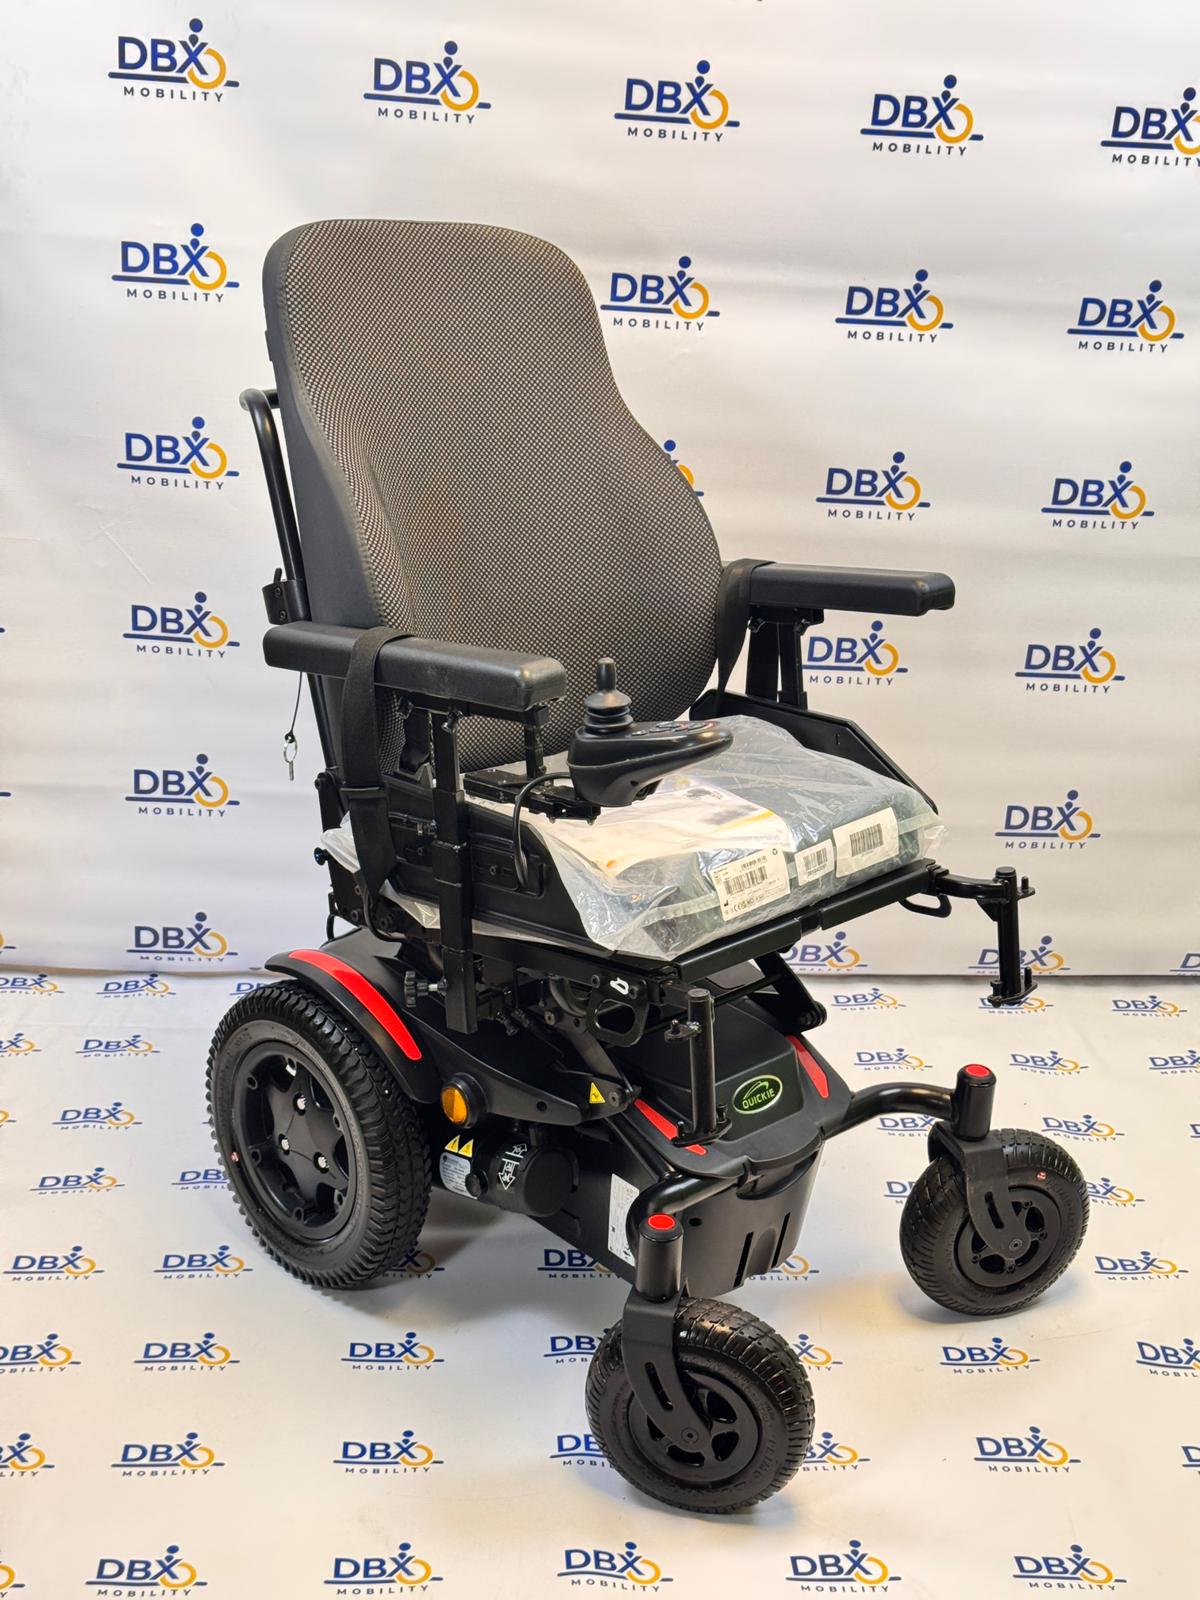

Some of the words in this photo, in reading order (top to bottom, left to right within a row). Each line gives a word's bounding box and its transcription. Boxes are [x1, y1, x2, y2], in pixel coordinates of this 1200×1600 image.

[118, 36, 209, 76] DBX
[374, 58, 463, 98] DBX
[124, 86, 224, 102] MOBILITY
[624, 78, 713, 116] DBX
[378, 107, 475, 124] MOBILITY
[870, 93, 960, 131] DBX
[1111, 106, 1198, 142] DBX
[627, 127, 724, 142] MOBILITY
[873, 142, 968, 156] MOBILITY
[121, 240, 209, 277] DBX
[127, 287, 225, 302] MOBILITY
[610, 273, 694, 307] DBX
[845, 286, 931, 320] DBX
[1077, 297, 1164, 330] DBX
[613, 317, 705, 331] MOBILITY
[847, 330, 938, 343] MOBILITY
[1078, 340, 1169, 353] MOBILITY
[124, 433, 210, 467] DBX
[131, 476, 225, 490] MOBILITY
[825, 467, 908, 499] DBX
[1051, 477, 1134, 509] DBX
[828, 509, 916, 521] MOBILITY
[1053, 519, 1139, 530] MOBILITY
[131, 604, 213, 637] DBX
[136, 644, 227, 658] MOBILITY
[806, 634, 887, 666] DBX
[1024, 642, 1106, 674] DBX
[809, 675, 894, 686] MOBILITY
[1026, 683, 1111, 694] MOBILITY
[133, 768, 213, 798] DBX
[138, 806, 227, 817] MOBILITY
[1003, 804, 1083, 833] DBX
[1005, 840, 1087, 849] MOBILITY
[134, 925, 213, 951] DBX
[103, 979, 160, 991] DBX
[833, 993, 886, 1004] DBX
[1112, 999, 1167, 1010] DBX
[83, 1039, 142, 1050] DBX
[856, 1051, 911, 1063] DBX
[1010, 1053, 1067, 1068] DBX
[742, 1088, 776, 1109] QUICKIE
[60, 1108, 123, 1121] DBX
[1042, 1117, 1103, 1133] DBX
[39, 1174, 106, 1188] DBX
[179, 1168, 227, 1182] DB
[1087, 1182, 1122, 1198] BX
[12, 1255, 84, 1270] DBX
[162, 1253, 232, 1269] DBX
[544, 1249, 600, 1267] DB
[1095, 1256, 1164, 1271] DBX
[143, 1341, 215, 1359] DBX
[349, 1341, 420, 1359] DBX
[550, 1335, 604, 1352] DB
[942, 1346, 1012, 1365] DBX
[1136, 1341, 1200, 1365] DBX
[0, 1366, 66, 1374] OBILITY
[953, 1365, 1030, 1375] MOBILITY
[1149, 1368, 1199, 1378] MOBIL
[120, 1444, 201, 1464] DBX
[341, 1440, 419, 1461] DBX
[975, 1436, 1057, 1459] DBX
[122, 1469, 210, 1477] MOBILITY
[345, 1466, 430, 1475] MOBILITY
[989, 1465, 1070, 1473] MOBILITY
[96, 1558, 184, 1581] DBX
[333, 1557, 417, 1580] DBX
[564, 1548, 643, 1576] DBX
[789, 1554, 874, 1578] DBX
[1013, 1556, 1096, 1576] DBX
[97, 1588, 192, 1598] MOBILITY
[337, 1585, 429, 1596] MOBILITY
[571, 1578, 660, 1592] MOBILITY
[801, 1584, 890, 1593] MOBILITY
[1029, 1582, 1116, 1591] MOBILITY
